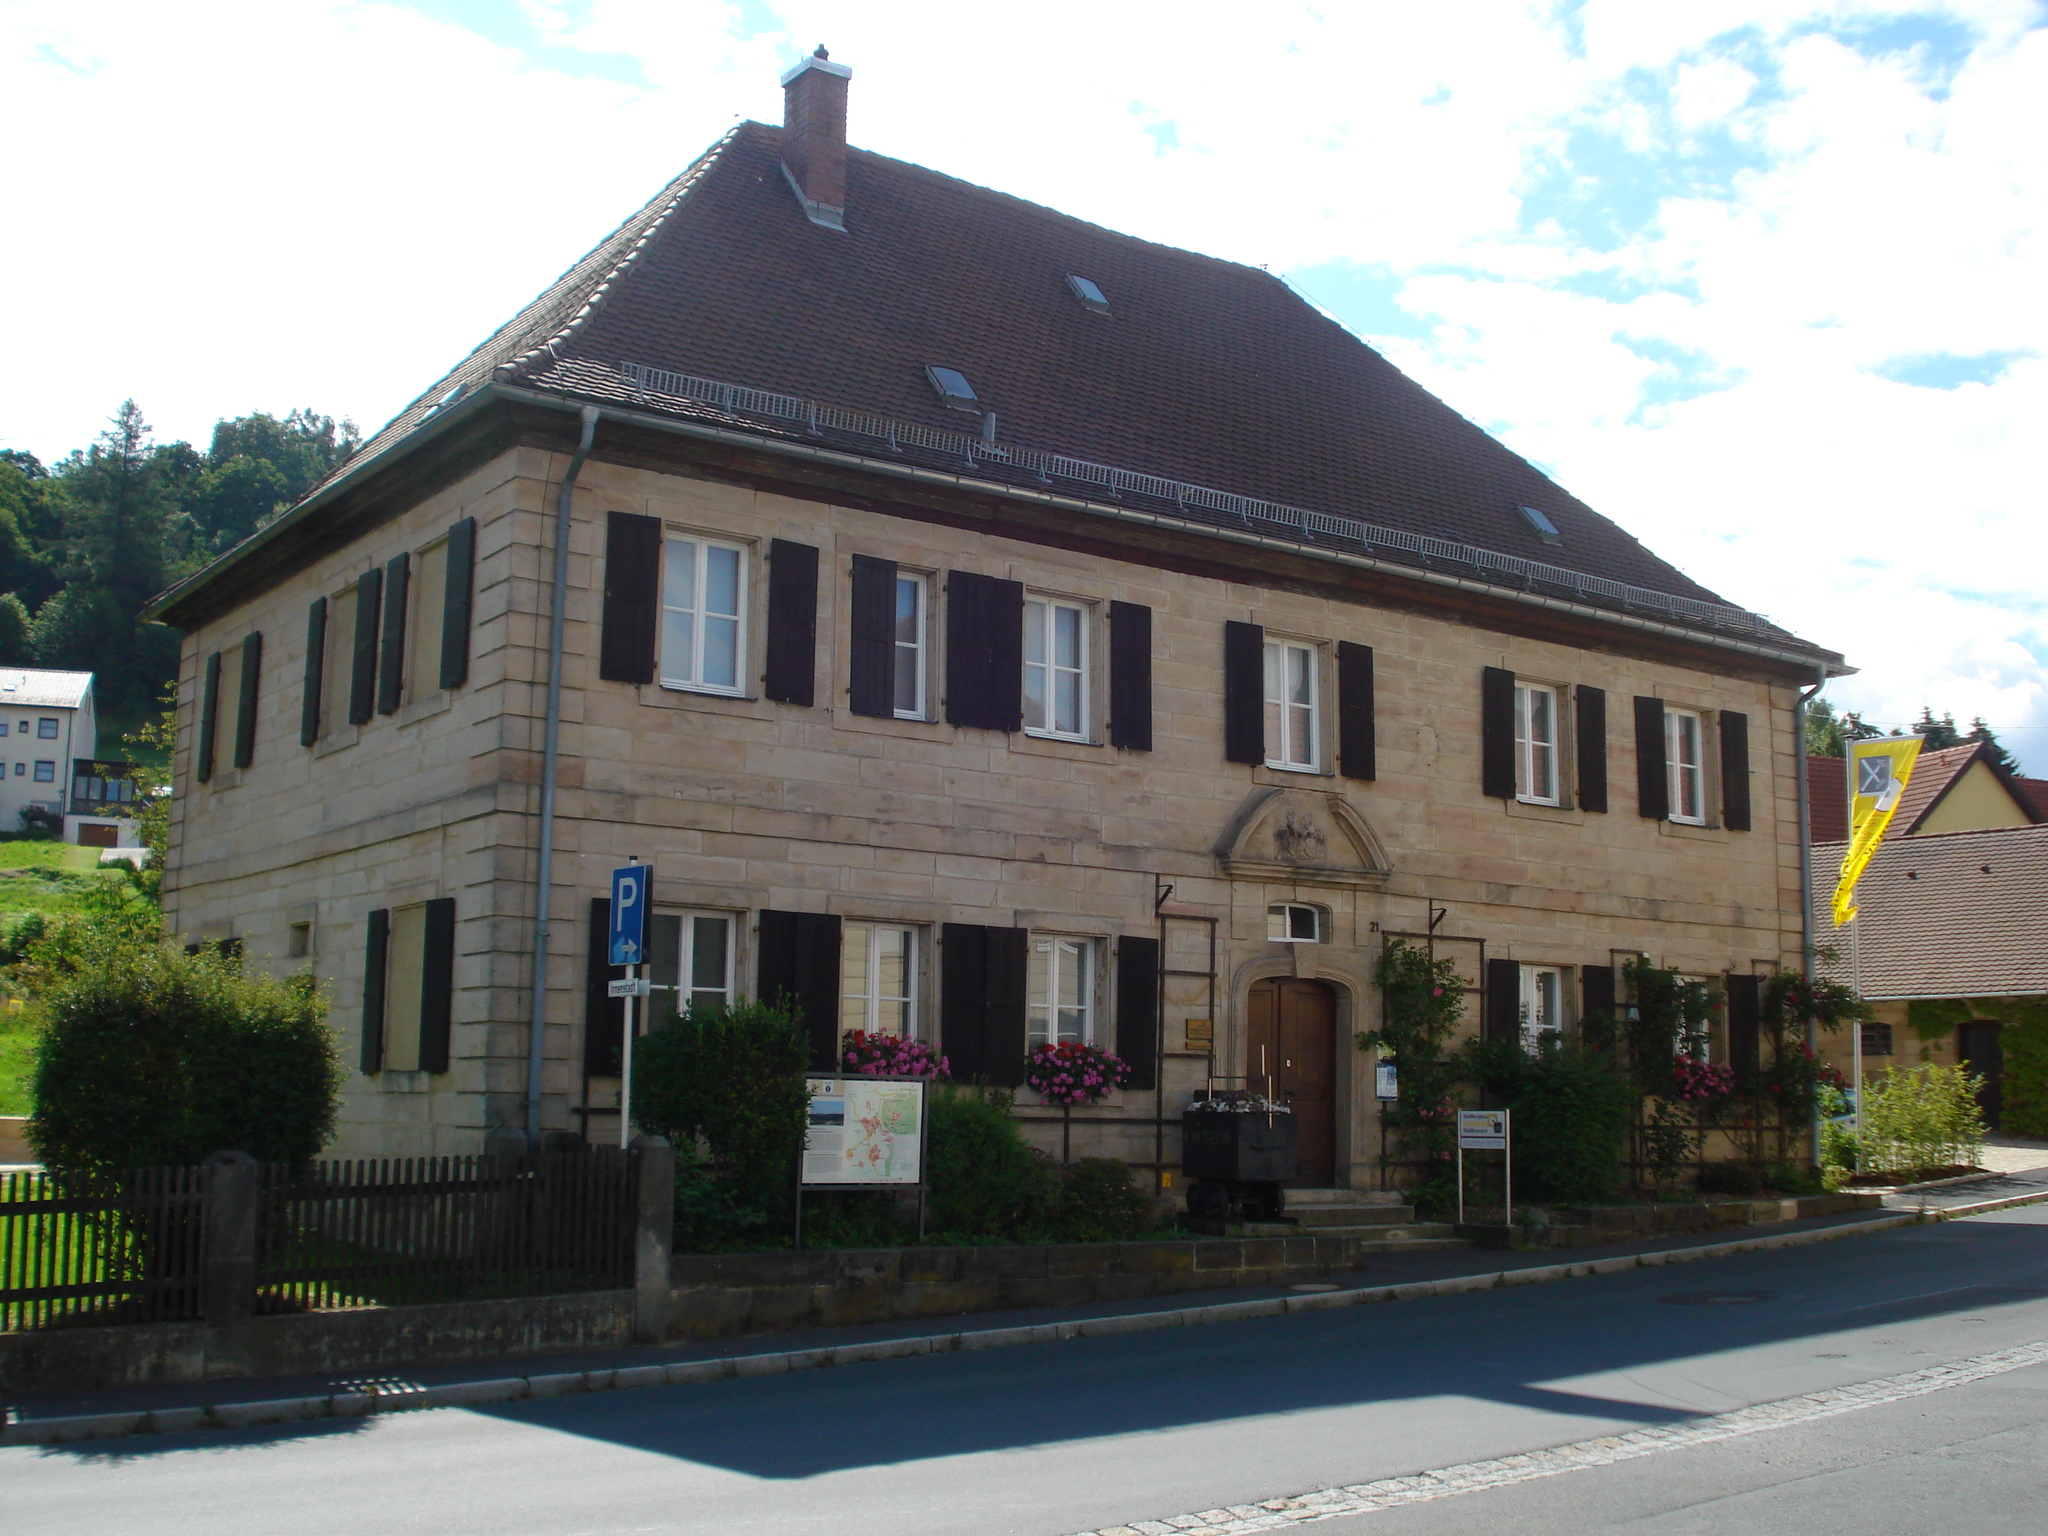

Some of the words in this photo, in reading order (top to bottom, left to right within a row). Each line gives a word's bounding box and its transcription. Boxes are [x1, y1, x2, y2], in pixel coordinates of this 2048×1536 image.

[617, 877, 637, 932] P
[1369, 921, 1379, 933] 21
[1190, 1130, 1231, 1146] MUSEUM
